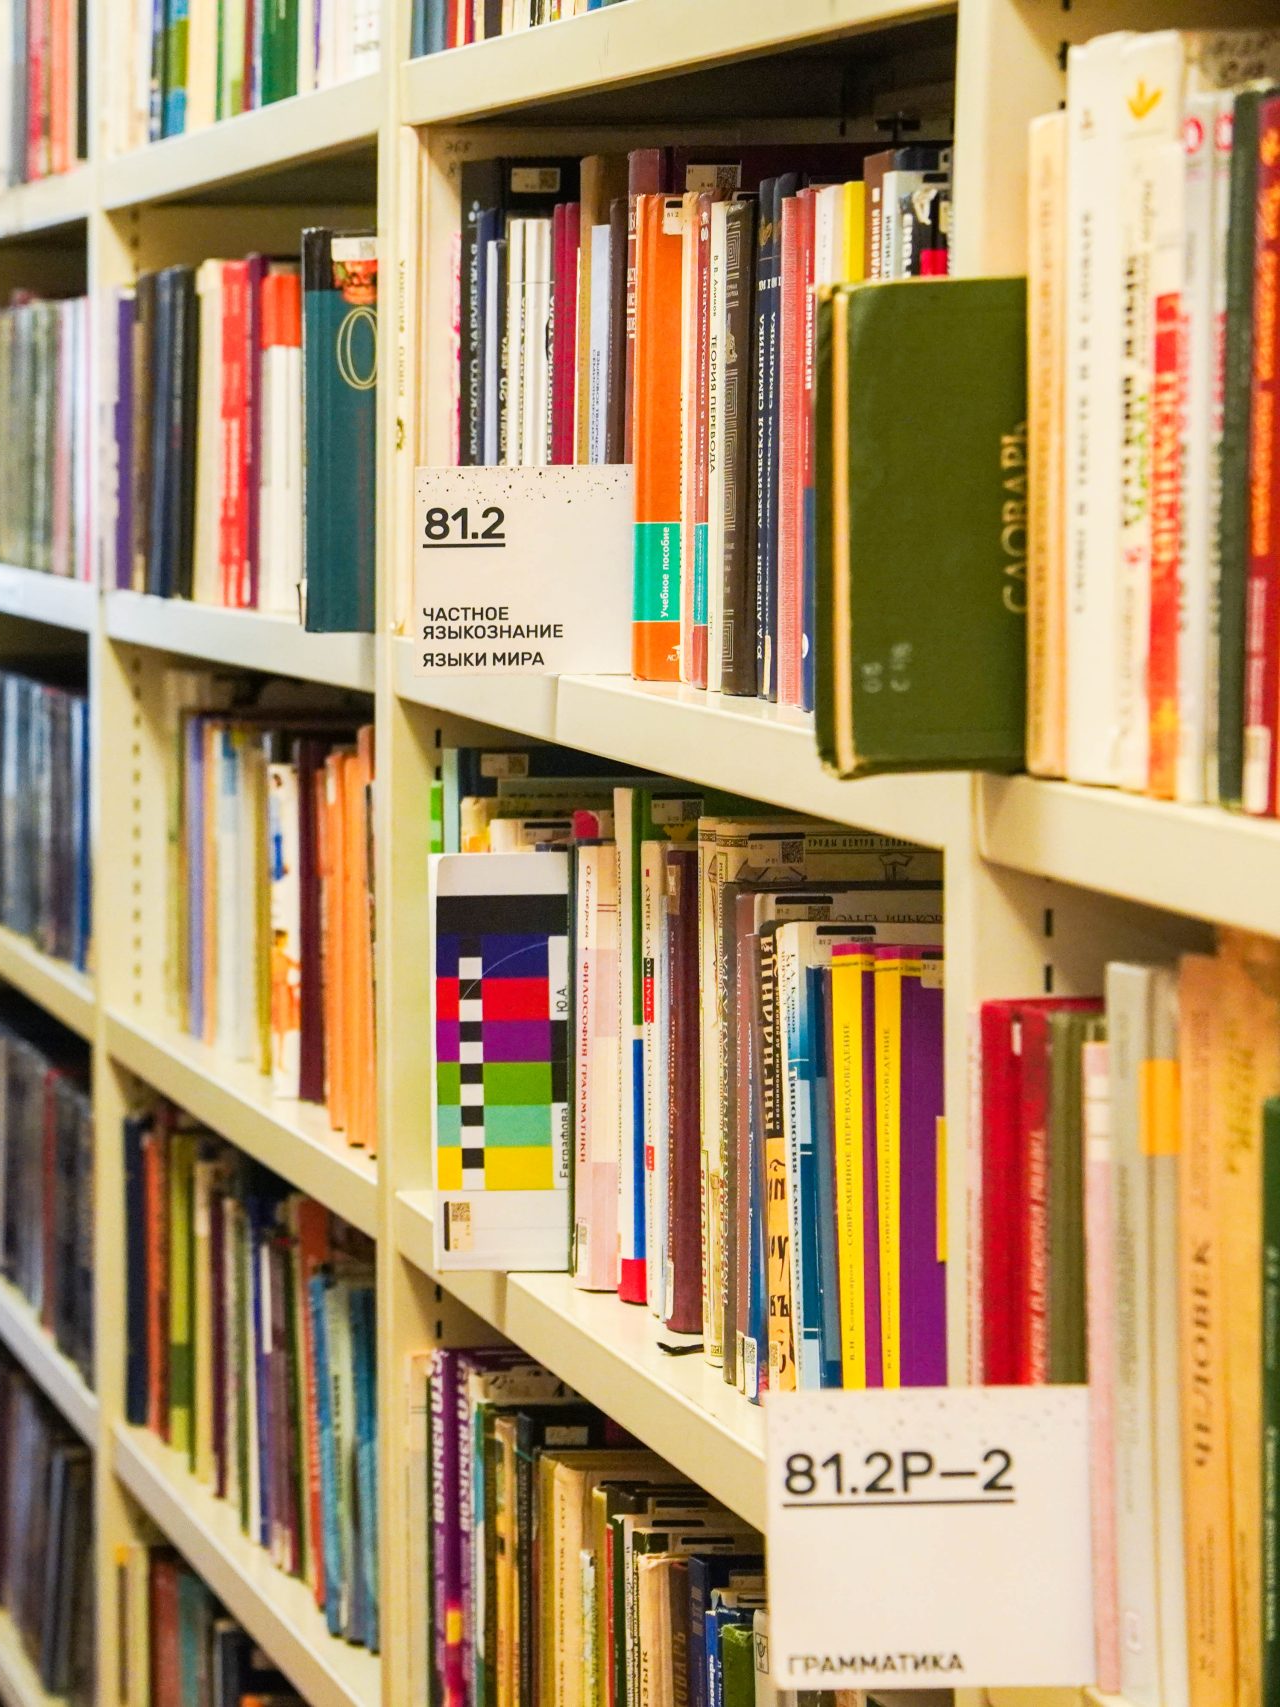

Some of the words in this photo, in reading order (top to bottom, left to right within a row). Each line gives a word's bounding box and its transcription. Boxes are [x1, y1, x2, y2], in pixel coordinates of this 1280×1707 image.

[700, 267, 708, 405] ПЕРЕВОДОВЕДЕНИЕ
[710, 336, 718, 391] ТЕОРИЯ
[757, 314, 766, 410] СЕМАНТИКА
[768, 312, 776, 408] СЕМАНТИКА
[546, 449, 552, 461] И
[423, 506, 506, 541] 81.2
[661, 527, 671, 570] пособие
[999, 420, 1027, 613] СЛОВАРЬ
[422, 606, 510, 622] ЧАСТНОЕ
[422, 623, 564, 639] ЯЗЫКОЗНАНИЕ
[660, 573, 671, 618] Учебное
[422, 651, 487, 667] ЯЗЫКИ
[491, 651, 545, 667] МИРА
[584, 880, 592, 939] Есперсен
[886, 914, 943, 922] ИНЬКОВ
[581, 962, 590, 1057] ФИЛОСОФИЯ
[579, 1063, 588, 1163] ГРАММАТИКИ
[843, 1022, 853, 1146] ПЕРЕВОДОВЕДЕНИЕ
[882, 1027, 891, 1152] ПЕРЕВОДОВЕДЕНИЕ
[558, 1106, 569, 1179] Евграфова
[845, 1151, 854, 1247] СОВРЕМЕННОЕ
[883, 1158, 891, 1253] СОВРЕМЕННОЕ
[848, 1263, 856, 1332] Комиссаров
[1192, 1242, 1213, 1467] ЧЕЛОВЕК
[432, 1416, 446, 1524] ЯЗЫКОВ
[673, 1631, 688, 1707] ОВАРЬ
[708, 1655, 717, 1707] ловарь
[788, 1653, 967, 1677] ГРАММАТИКА
